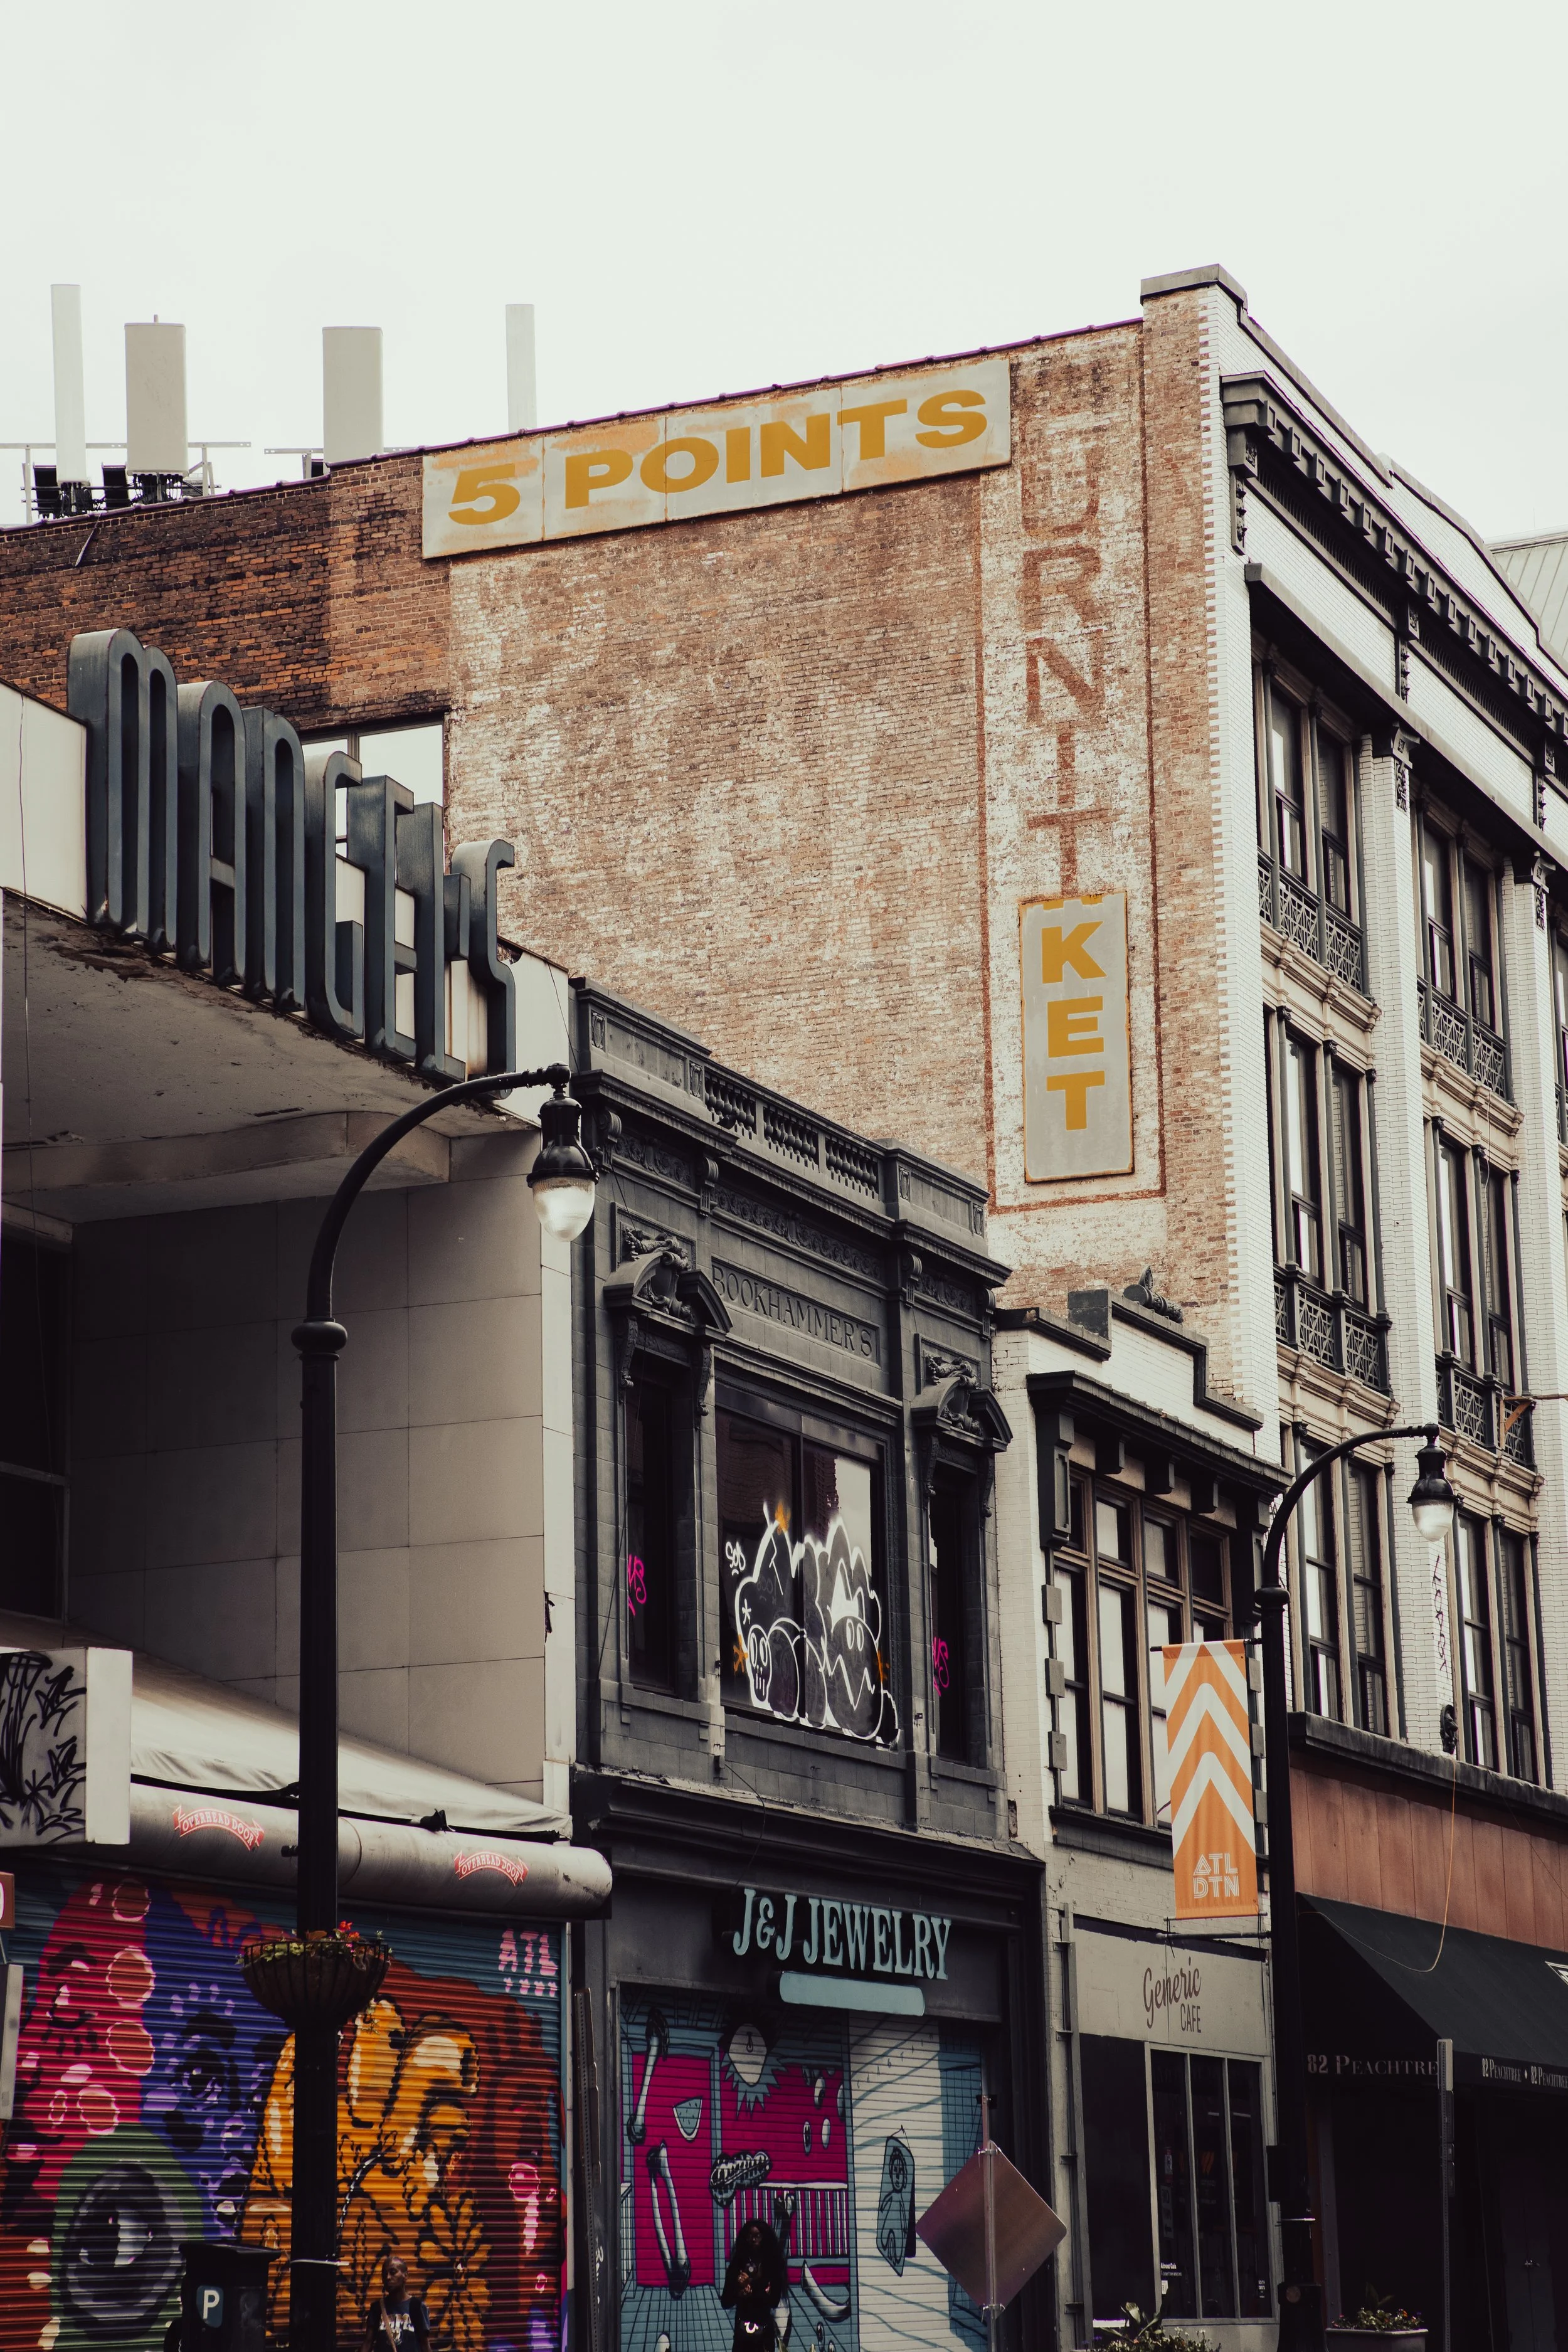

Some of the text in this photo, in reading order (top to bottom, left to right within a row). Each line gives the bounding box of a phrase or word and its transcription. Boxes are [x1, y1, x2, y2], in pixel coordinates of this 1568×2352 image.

[448, 389, 987, 526] 5 POINTS
[712, 1263, 872, 1357] BOOKHAMMER'S
[182, 1811, 255, 1846] OVERHEAD DOOR
[462, 1854, 520, 1883] OVERHEAD DOOR
[1193, 1852, 1239, 1876] ATL
[1193, 1875, 1240, 1899] DTN
[733, 1888, 952, 1981] J&J JEWELRY
[499, 1929, 558, 1976] ATL
[1143, 1956, 1202, 2029] Generic
[1180, 2003, 1202, 2033] CAFE
[1307, 2054, 1328, 2074] 82
[1482, 2058, 1489, 2077] 82
[1530, 2065, 1537, 2084] 82
[203, 2290, 220, 2319] P
